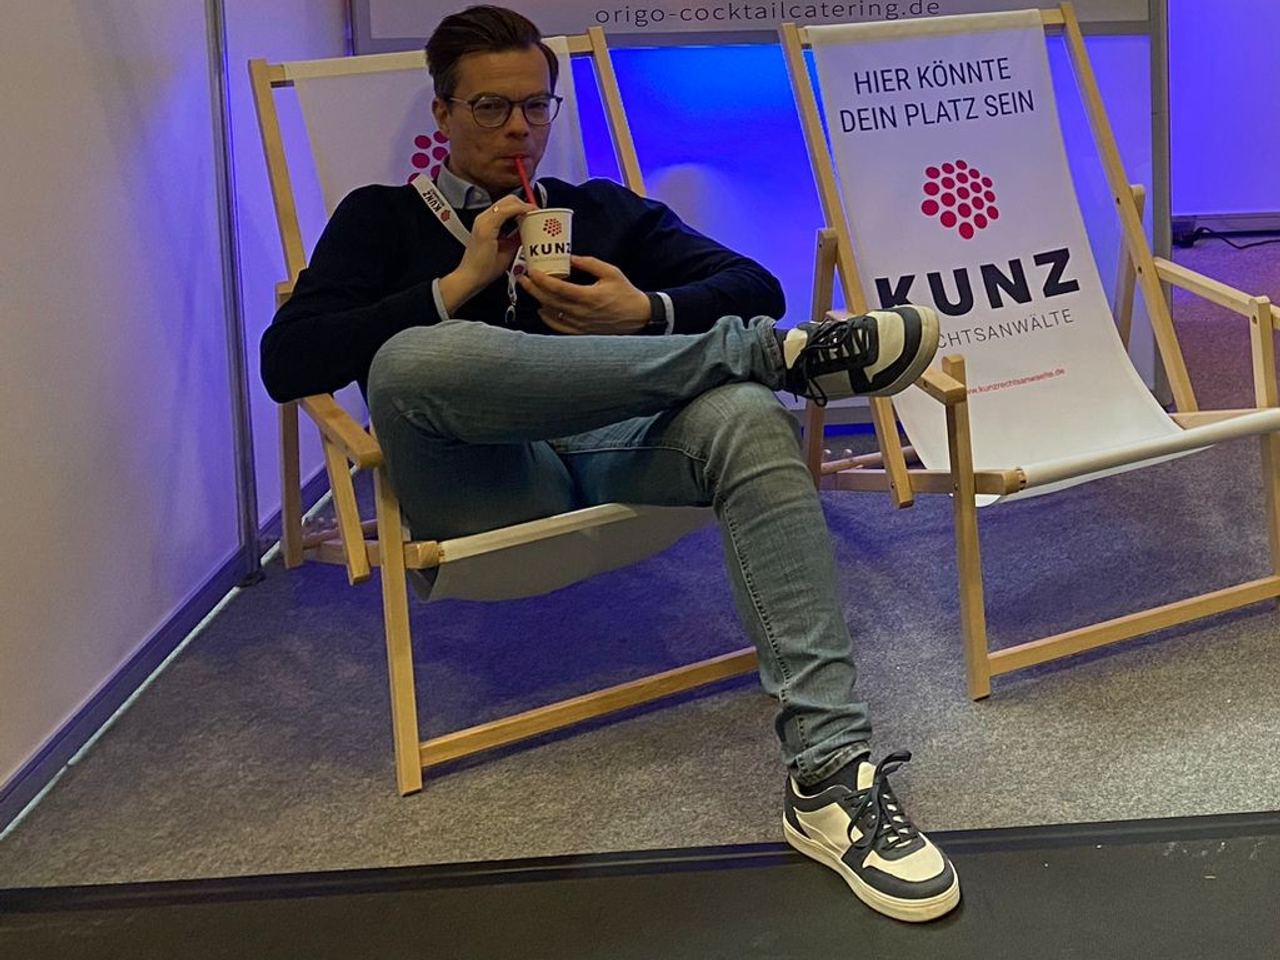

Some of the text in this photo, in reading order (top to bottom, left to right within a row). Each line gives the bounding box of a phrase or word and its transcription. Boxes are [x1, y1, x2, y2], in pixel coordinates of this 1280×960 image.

[854, 57, 1011, 95] HIER KÖNNTE
[840, 90, 1034, 133] DEIN PLATZ SEIN
[422, 191, 442, 212] KUNZ
[874, 247, 1080, 316] KUNZ
[939, 309, 1074, 349] CHTSANWÄLTE
[967, 368, 1065, 394] w.kunzrechtsanwaelte.de
